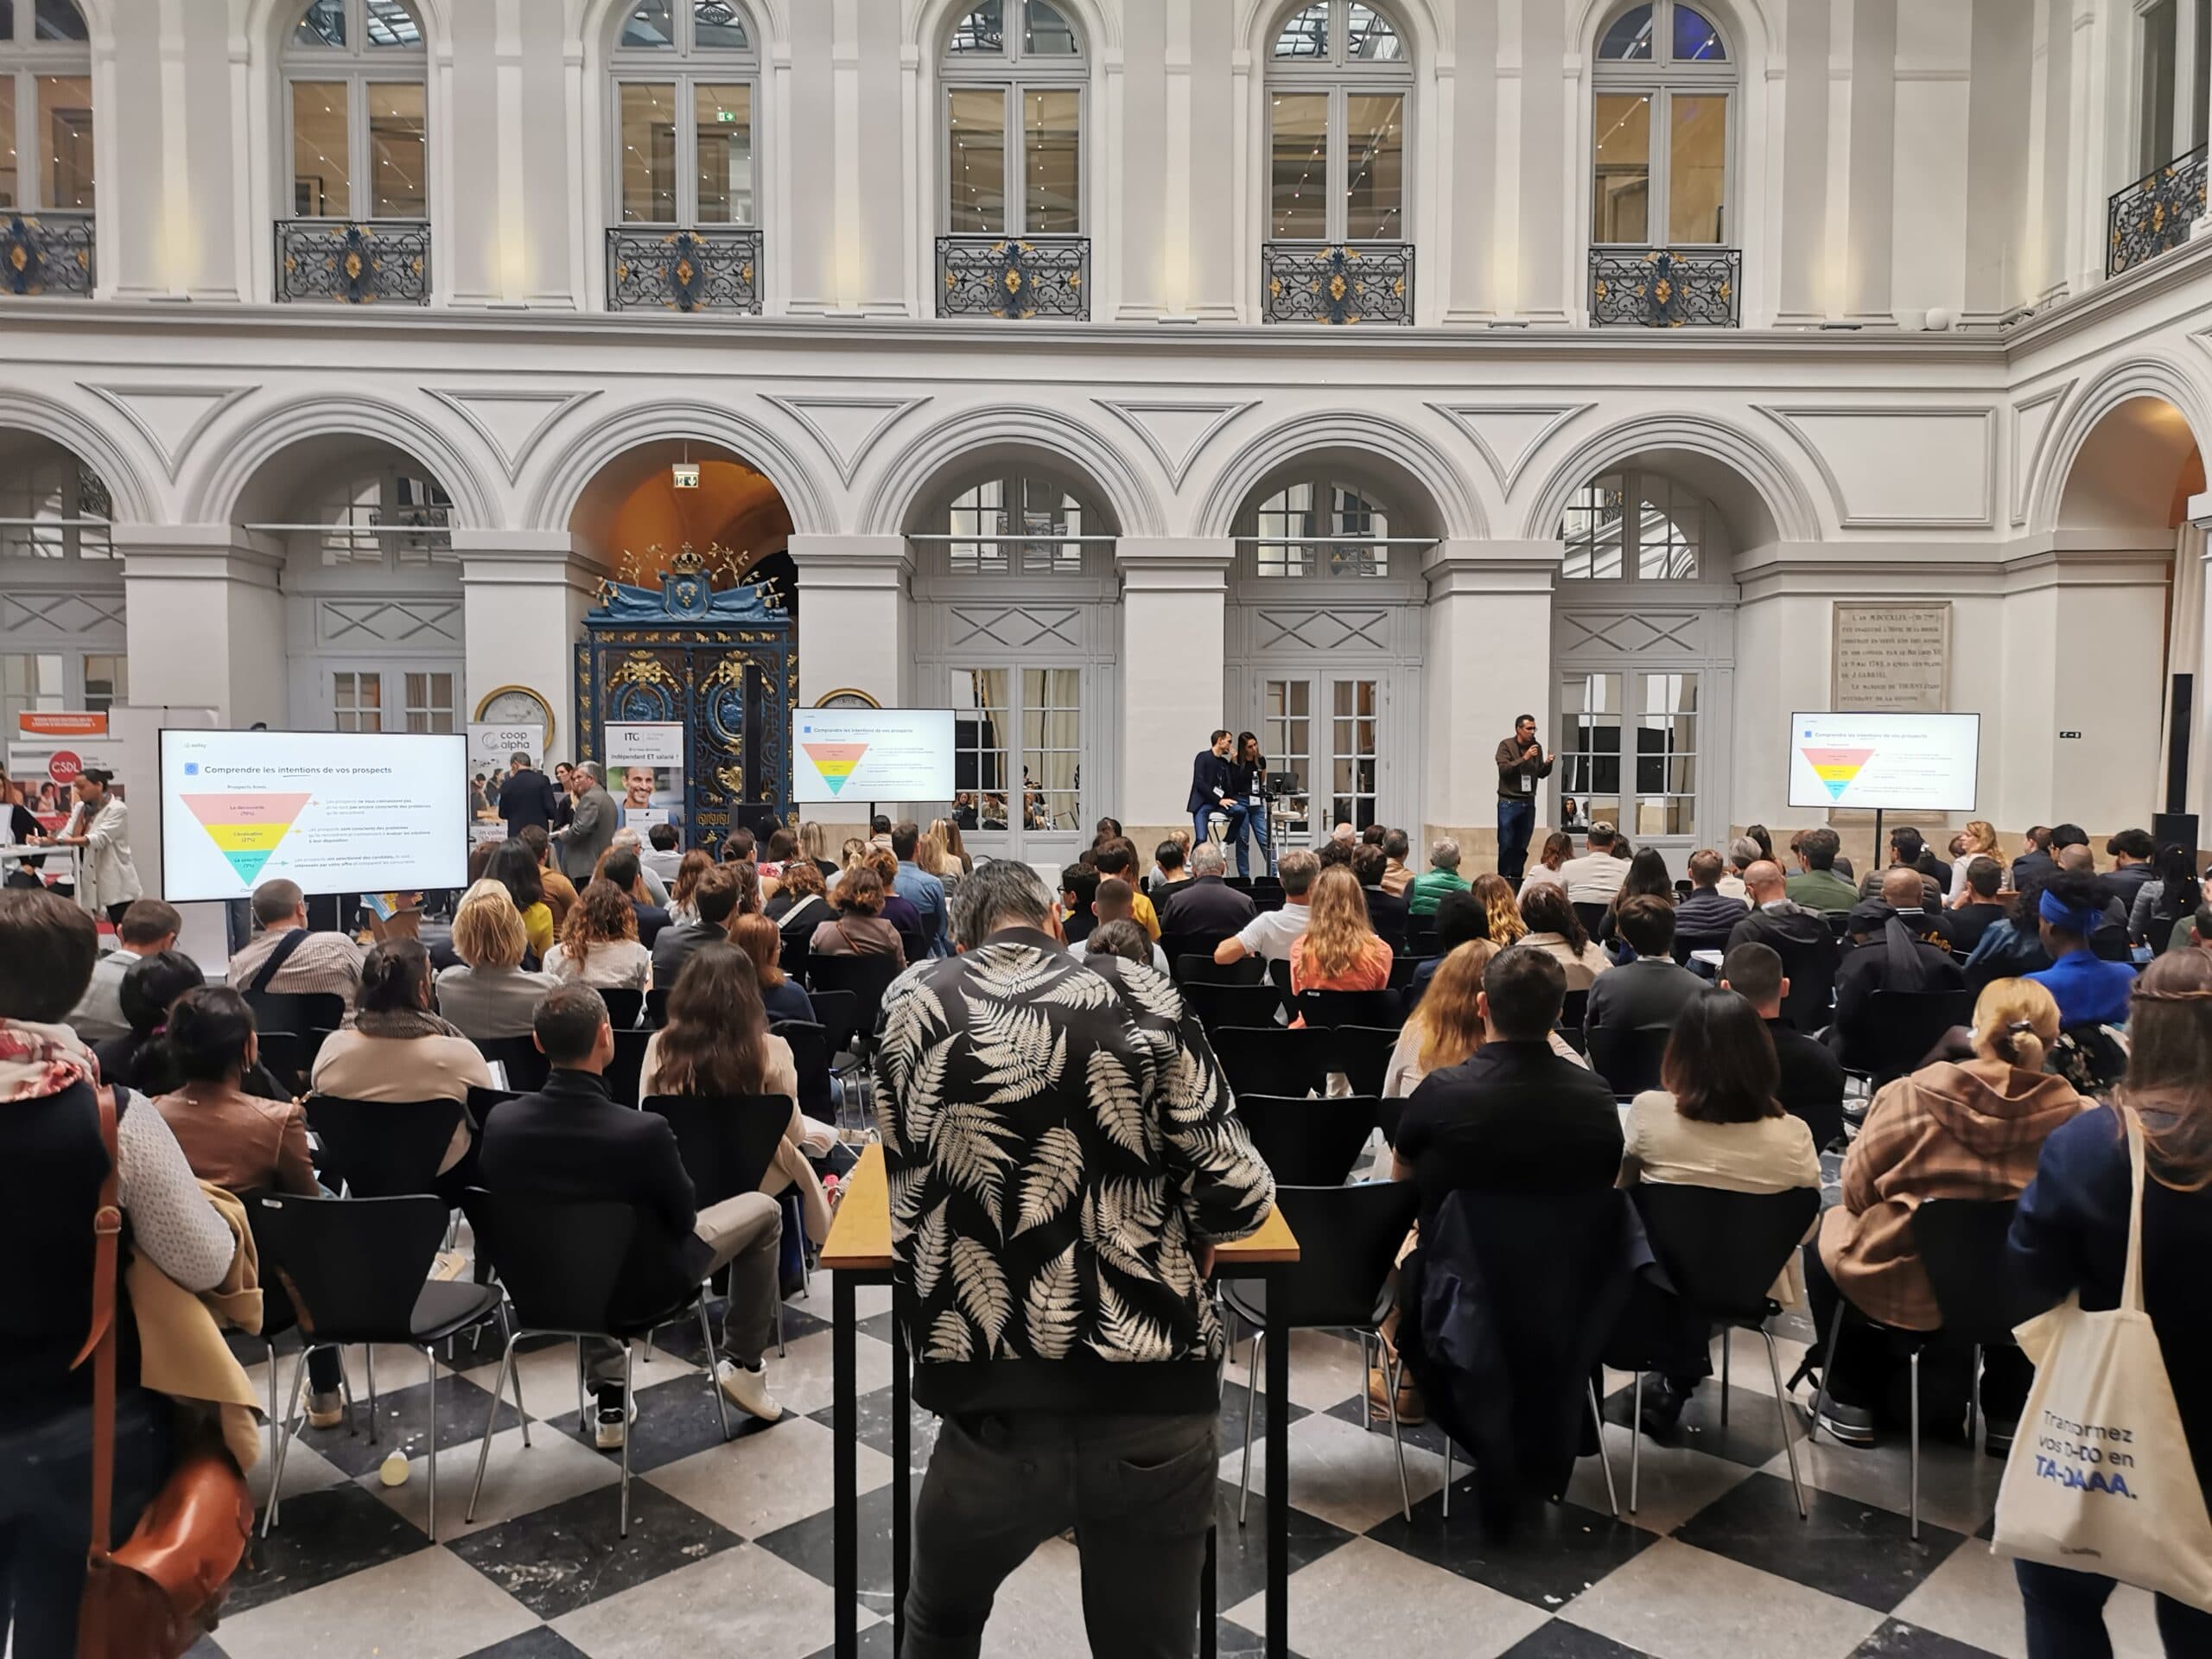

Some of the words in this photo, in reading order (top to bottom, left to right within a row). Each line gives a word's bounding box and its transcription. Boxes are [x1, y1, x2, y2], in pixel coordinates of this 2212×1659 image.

[501, 732, 527, 741] coop
[624, 733, 640, 741] ITG
[501, 740, 530, 750] alpha
[52, 761, 81, 773] CSDL
[205, 766, 261, 774] Comprendre
[2039, 1434, 2062, 1453] vos
[2109, 1452, 2134, 1468] en
